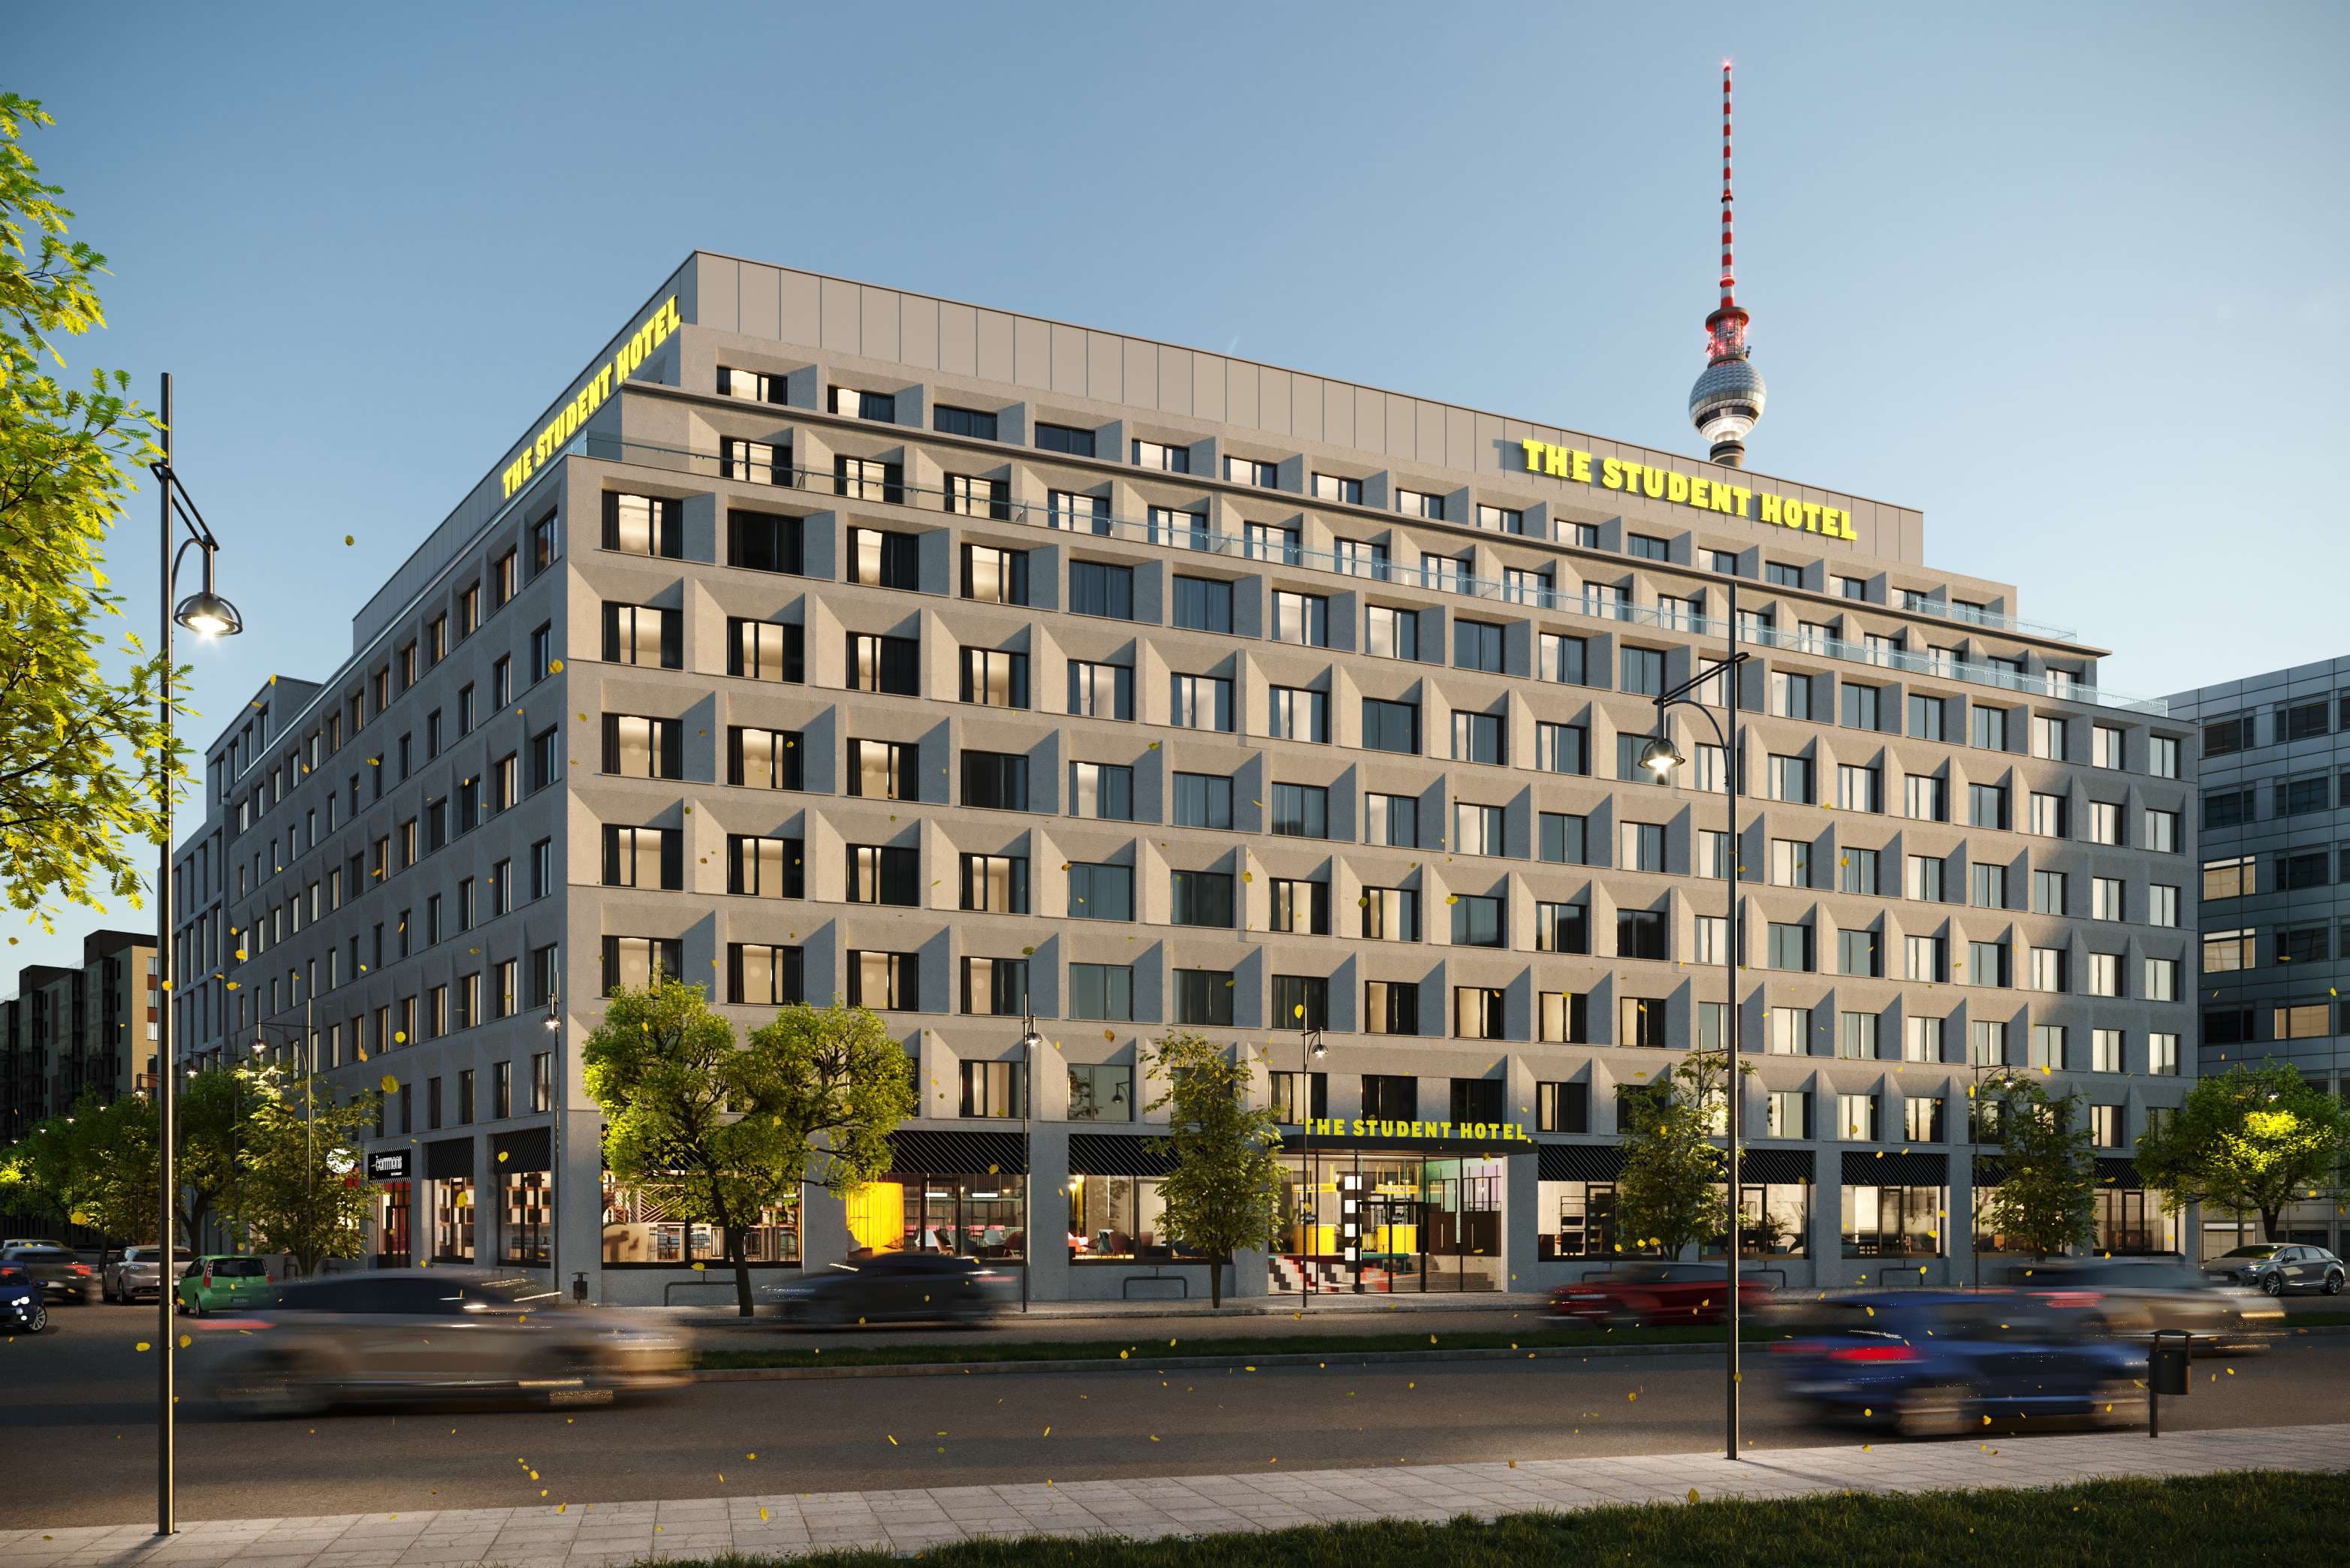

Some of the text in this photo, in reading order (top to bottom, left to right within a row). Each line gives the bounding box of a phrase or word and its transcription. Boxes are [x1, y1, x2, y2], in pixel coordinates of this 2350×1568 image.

[502, 294, 680, 499] THE STUDENT HOTEL
[1522, 438, 1858, 541] THE STUDENT HOTEL
[1353, 1120, 1451, 1138] STUDENT
[1460, 1123, 1527, 1140] HOTEL
